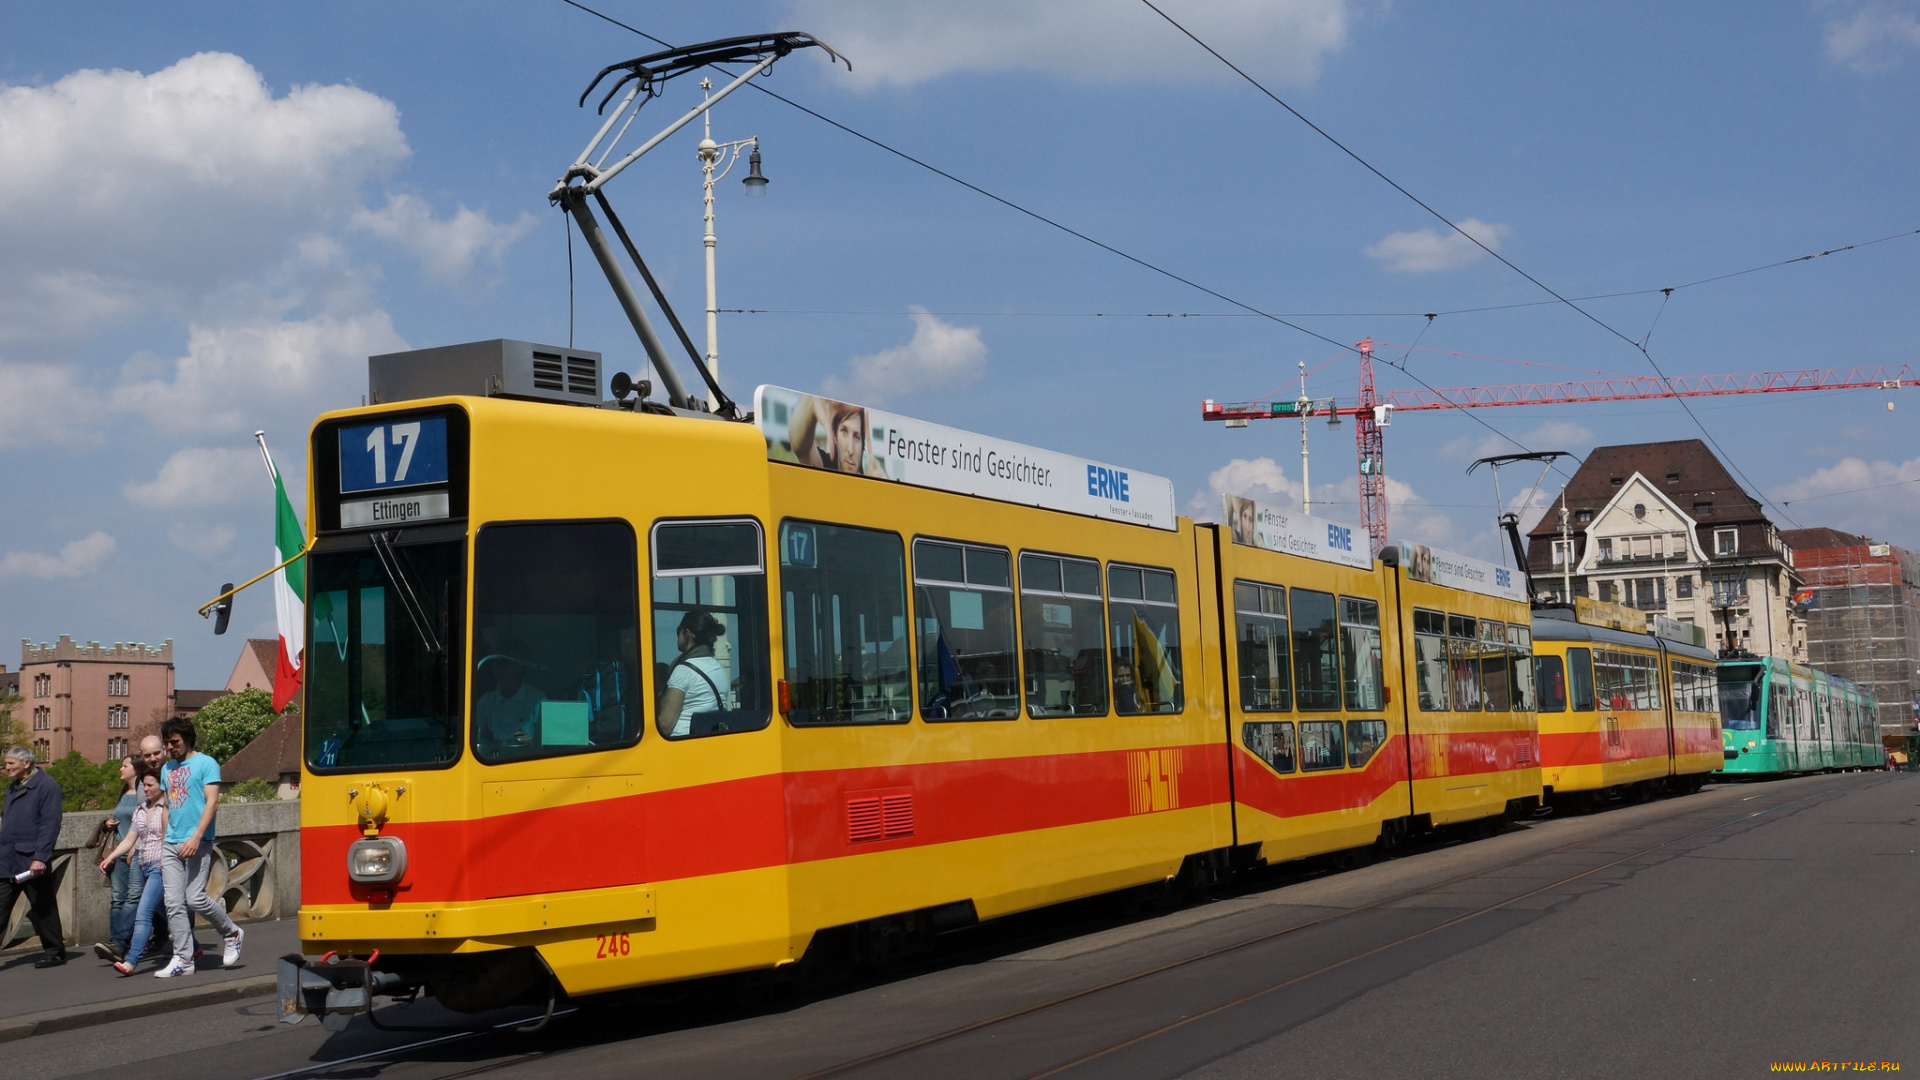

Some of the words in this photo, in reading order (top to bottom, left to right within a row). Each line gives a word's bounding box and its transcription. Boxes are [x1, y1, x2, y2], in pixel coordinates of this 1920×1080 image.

[366, 422, 421, 484] 17
[888, 428, 947, 466] Fenster
[952, 443, 982, 474] sind
[987, 451, 1052, 488] Gesichter.
[1087, 464, 1129, 503] ERNE
[373, 500, 421, 521] Ettingen
[1264, 508, 1288, 529] Fenster
[790, 531, 808, 561] 17
[1273, 532, 1287, 549] sind
[1288, 534, 1319, 555] Gesichter.
[1327, 523, 1352, 552] ERNE
[1495, 567, 1511, 589] ERNE
[1126, 748, 1183, 815] BLT
[596, 931, 630, 959] 246
